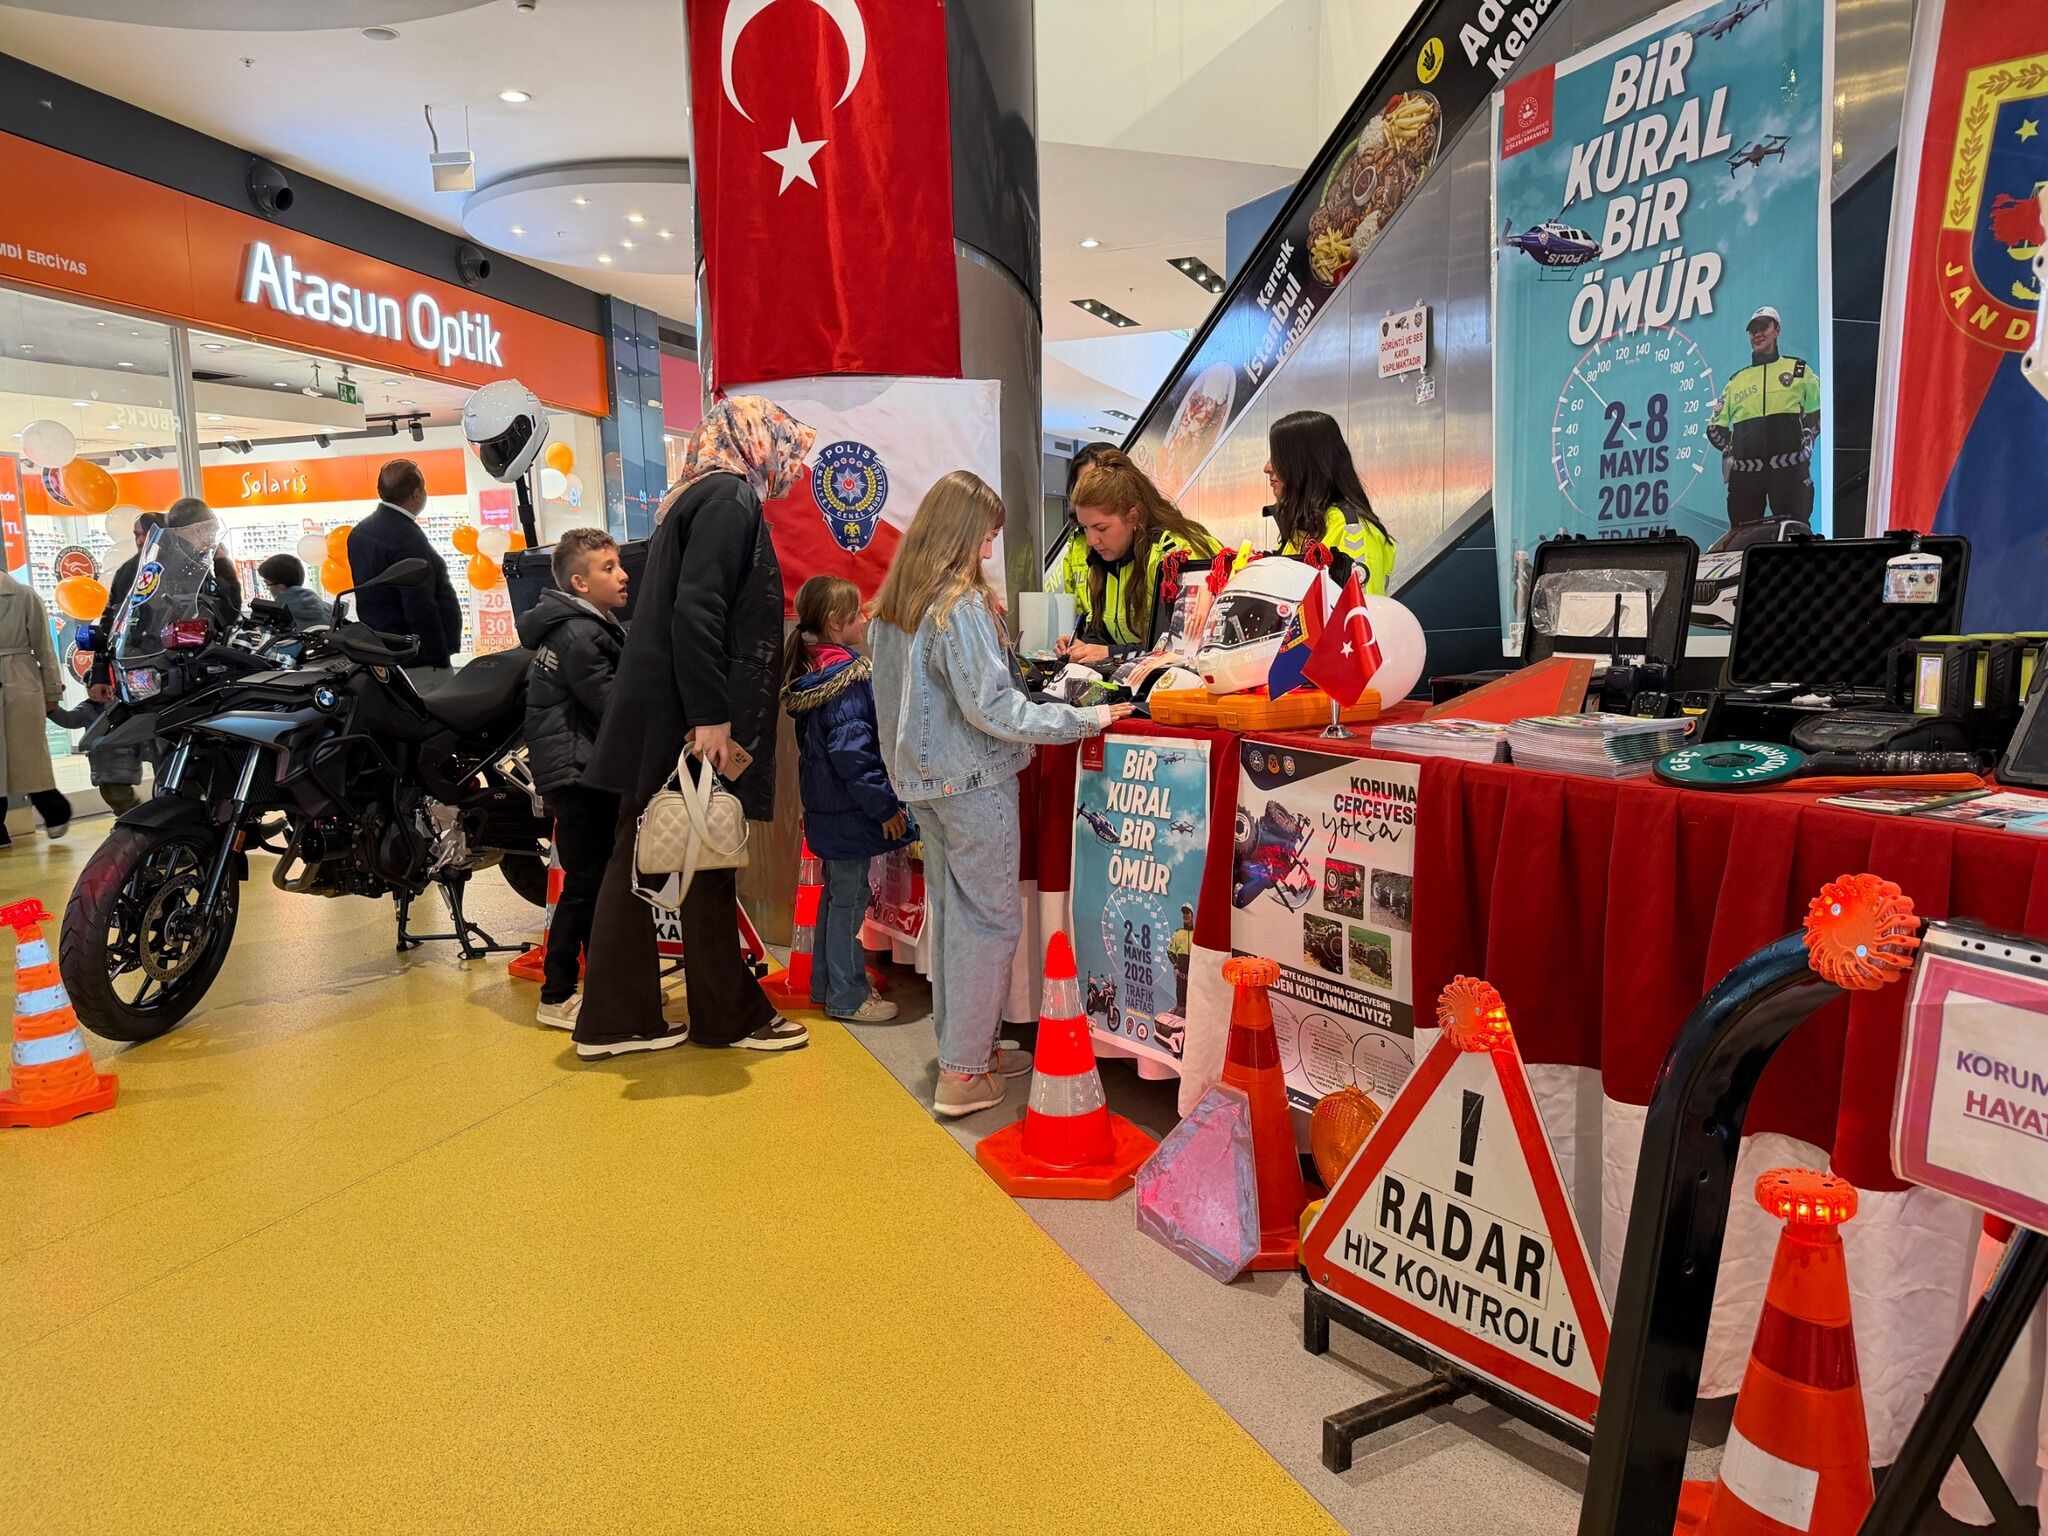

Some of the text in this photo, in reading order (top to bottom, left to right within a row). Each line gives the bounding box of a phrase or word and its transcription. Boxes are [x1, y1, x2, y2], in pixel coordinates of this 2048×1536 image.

[1459, 0, 1512, 67] Ad
[1602, 31, 1693, 125] BİR
[1564, 87, 1733, 206] KURAL
[1602, 178, 1688, 261] BİR
[26, 249, 88, 276] ERCİYAS
[1257, 238, 1295, 312] Karışık
[243, 243, 503, 367] Atasun Optik
[1567, 253, 1722, 348] ÖMÜR
[1945, 261, 2031, 341] JAND
[1243, 271, 1302, 385] İstanbul
[1380, 332, 1423, 352] GÖRÜNTÜ VE SES
[1382, 355, 1421, 374] YAPILMAKTADIR
[1394, 348, 1409, 360] KAYDI
[1566, 342, 1699, 477] 0 20 40 60 80 100 120 140 160 180 200 220 240 260
[1602, 393, 1668, 450] 2-8
[825, 444, 871, 460] POLİS
[1600, 445, 1670, 480] MAYIS
[241, 468, 308, 500] Solaris
[1598, 479, 1669, 521] 2026
[836, 511, 866, 520] GENEL
[484, 593, 505, 609] 20
[485, 617, 508, 635] 30
[1122, 749, 1158, 782] BİR
[1670, 750, 1702, 772] GEÇ
[1732, 743, 1790, 778] JANDARMA
[1106, 781, 1172, 819] KURAL
[1350, 776, 1417, 805] KORUMA
[1119, 817, 1156, 852] BİR
[1322, 811, 1403, 854] yoksa
[1108, 849, 1170, 896] ÖMÜR
[652, 905, 681, 921] TR
[1124, 919, 1151, 950] 2-8
[1123, 944, 1152, 965] MAYIS
[1124, 961, 1153, 987] 2026
[1297, 973, 1316, 987] KARŞI
[1316, 980, 1345, 997] KORUMA
[1125, 996, 1154, 1016] HAFTASI
[1295, 983, 1393, 1028] KULLANMALIYIZ?
[1322, 1020, 1328, 1028] 2
[1380, 1039, 1386, 1048] 3
[1379, 1174, 1546, 1301] RADAR
[1344, 1229, 1577, 1369] HIZ KONTROLÜ
